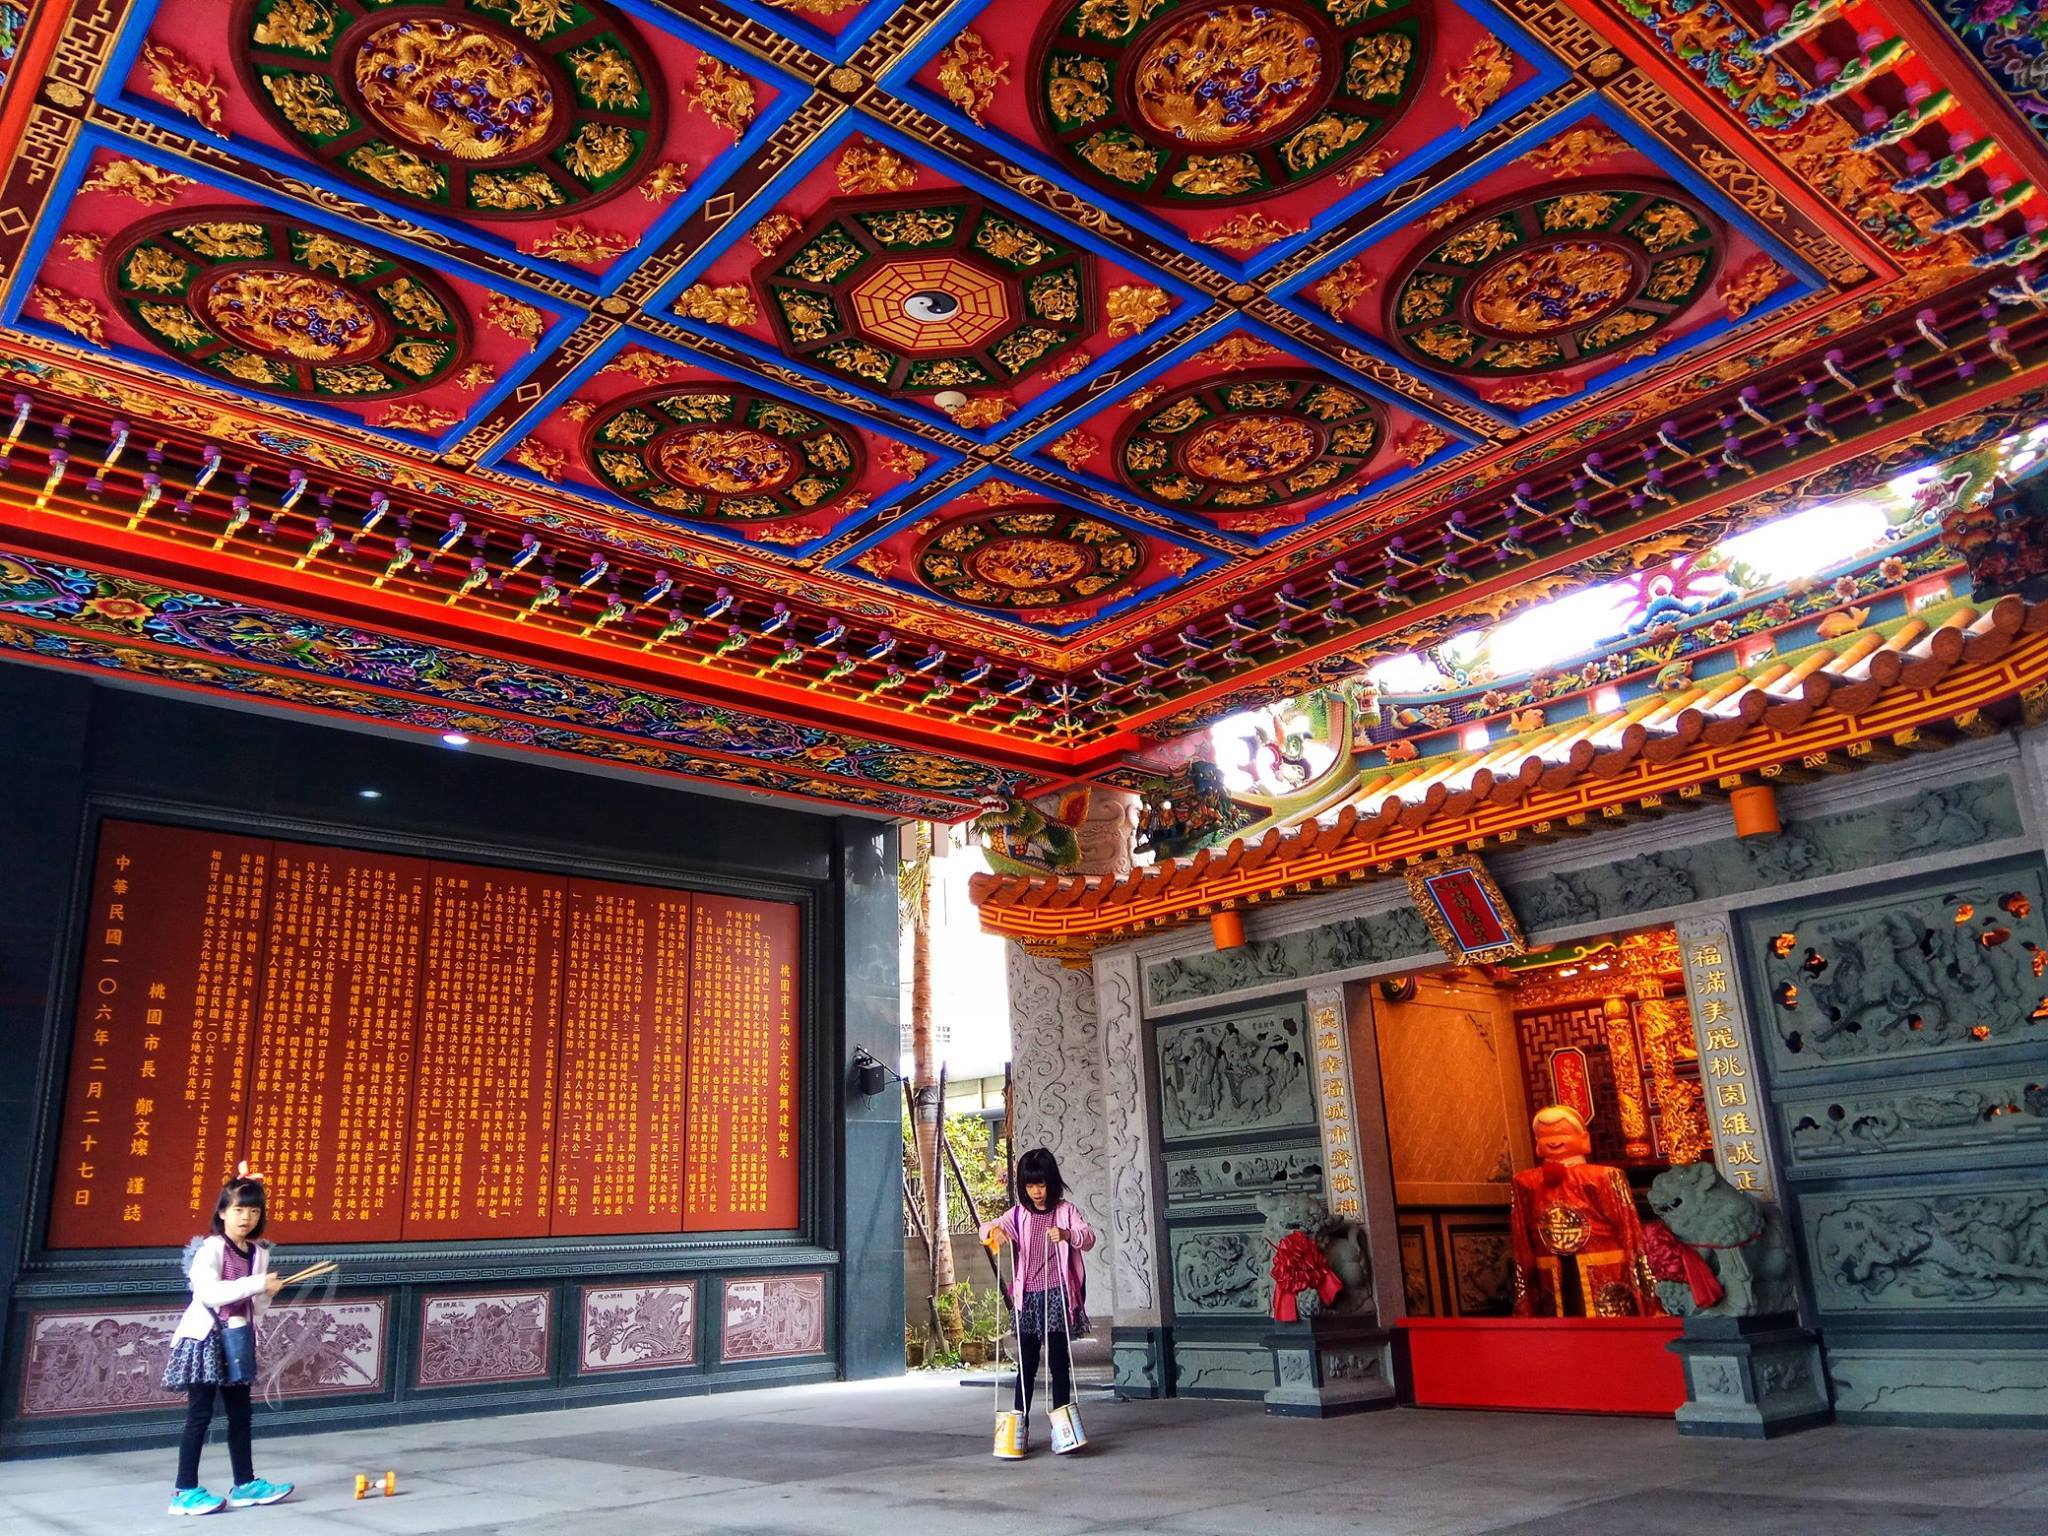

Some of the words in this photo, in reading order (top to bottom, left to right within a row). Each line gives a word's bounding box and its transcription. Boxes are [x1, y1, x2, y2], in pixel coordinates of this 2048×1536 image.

[137, 981, 168, 1079] 桃園市長
[778, 963, 790, 1158] 桃園市土地公文化館興建始末
[128, 1096, 155, 1157] 鄭文燦
[121, 1176, 146, 1222] 謹誌
